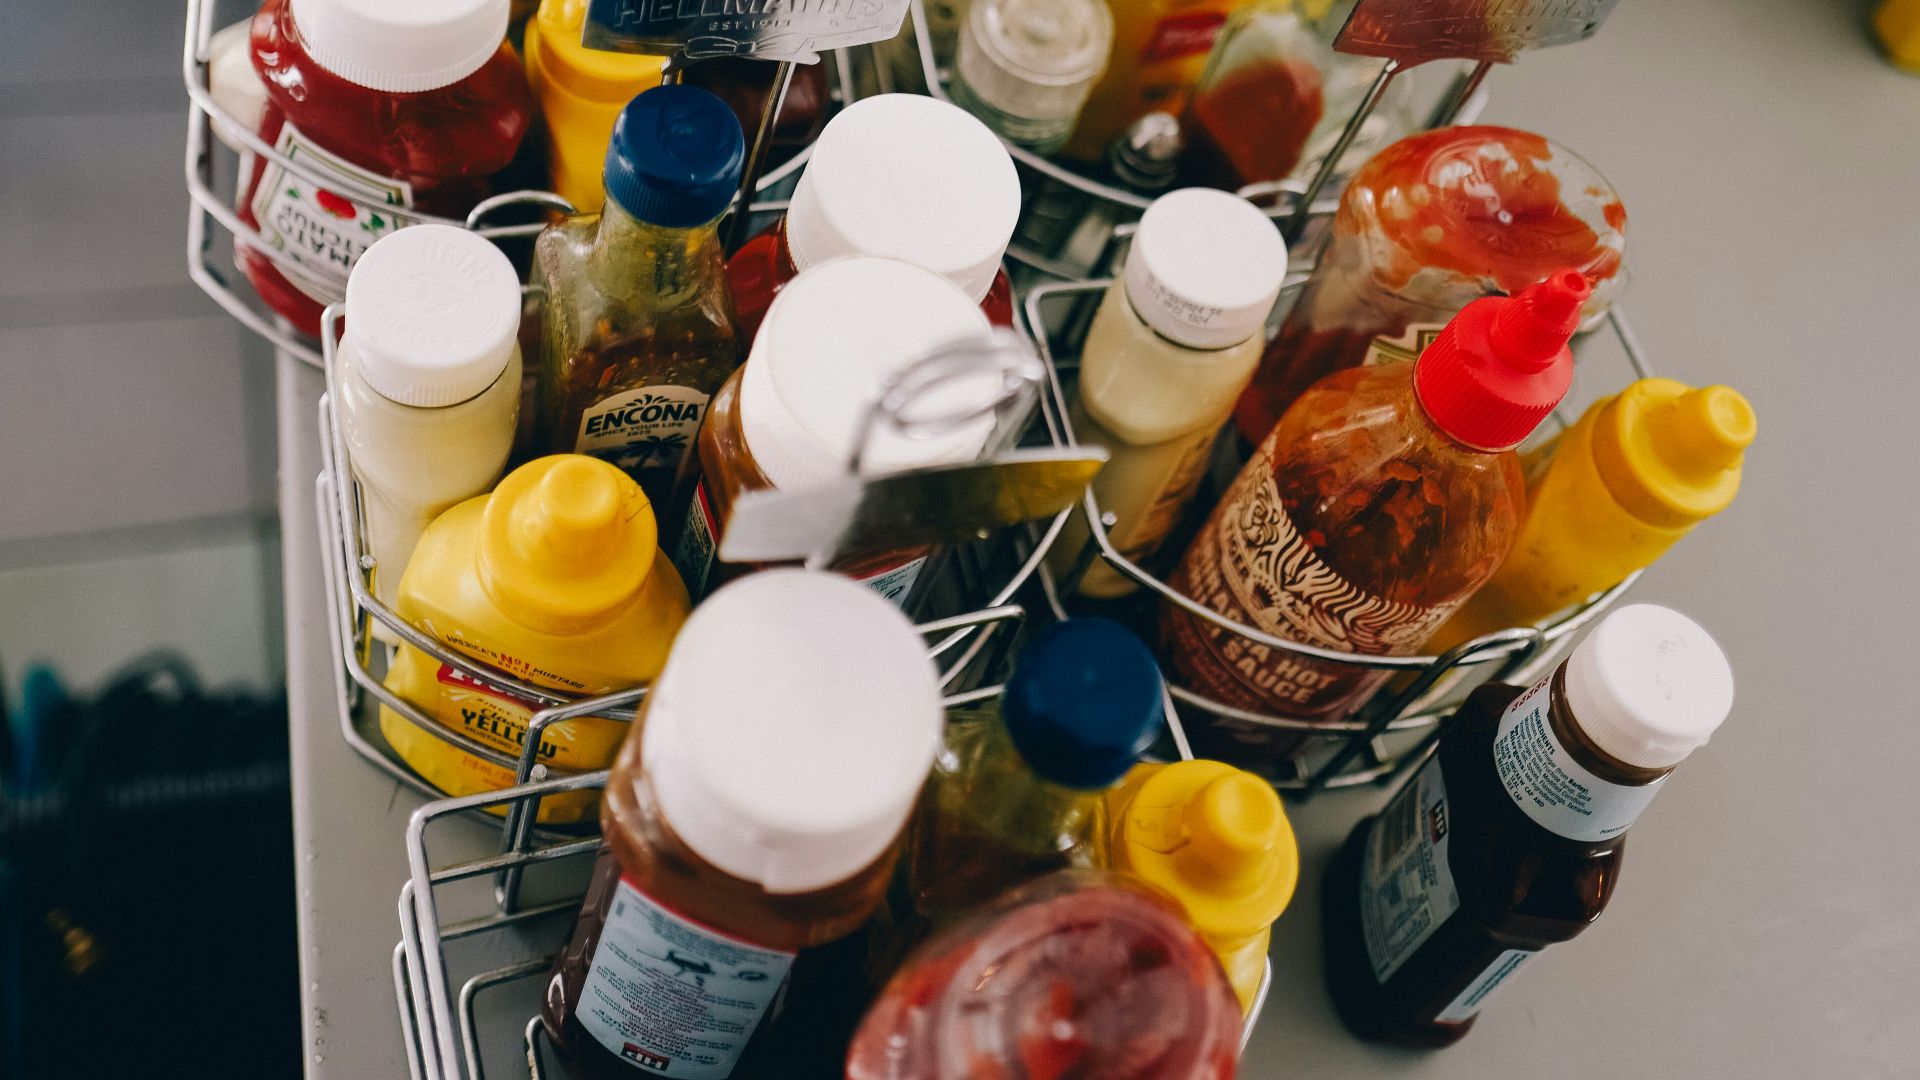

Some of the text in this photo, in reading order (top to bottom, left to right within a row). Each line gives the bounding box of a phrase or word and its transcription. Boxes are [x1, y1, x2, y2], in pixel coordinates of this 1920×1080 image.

[276, 213, 355, 267] MATO
[585, 403, 698, 435] ENCONA
[630, 423, 659, 432] YOUR
[661, 421, 684, 429] LIFE
[497, 660, 535, 678] BRAND
[533, 667, 586, 690] MUSTARD
[1223, 639, 1314, 701] SAUCE
[1275, 659, 1338, 689] HOT
[1534, 707, 1556, 755] INGREDIENTS
[1509, 729, 1557, 806] Allergens: see ingredients
[1541, 749, 1556, 768] Vinegar
[1509, 759, 1525, 785] UNSCREW
[1523, 786, 1533, 797] CAP
[1532, 796, 1545, 808] AND
[1531, 757, 1541, 775] Dates,
[1541, 772, 1562, 792] Modified
[1513, 790, 1522, 801] CAP
[1538, 779, 1565, 806] Flavourings,
[1567, 801, 1591, 815] Tamarind
[598, 1009, 636, 1036] SAUCE
[626, 1051, 663, 1069] HP
